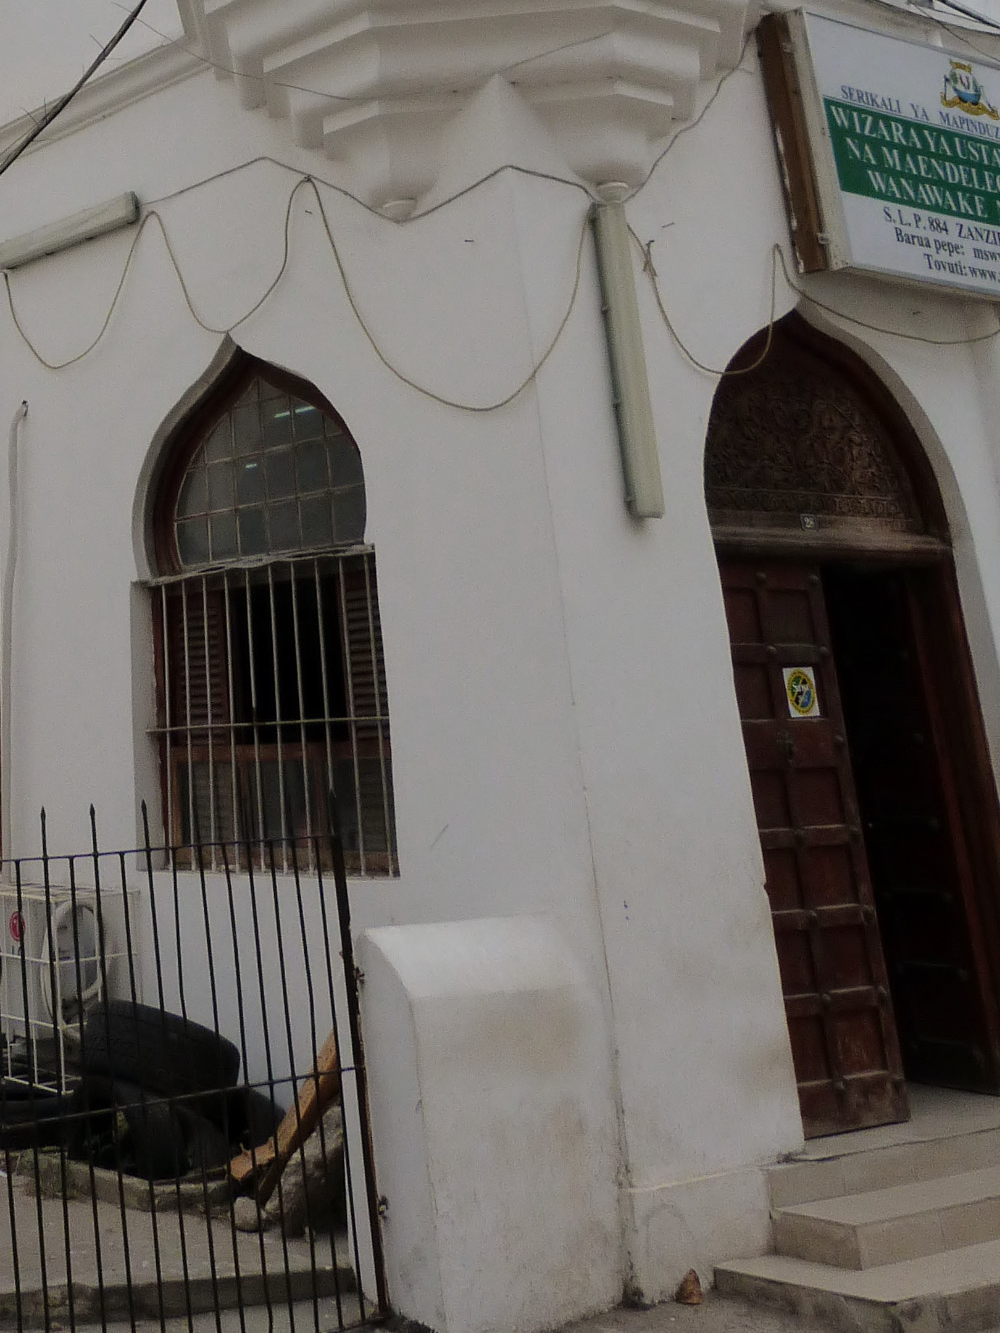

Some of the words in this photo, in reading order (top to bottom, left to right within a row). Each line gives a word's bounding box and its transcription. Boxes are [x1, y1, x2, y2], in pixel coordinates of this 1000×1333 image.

[841, 85, 901, 114] SERIKALI
[909, 103, 930, 121] YA
[830, 105, 922, 149] WIZARA
[923, 130, 952, 156] YA
[954, 137, 1000, 168] USTA
[845, 137, 876, 165] NA
[867, 169, 988, 218] WANAWAKE
[894, 226, 931, 249] Barua
[934, 238, 965, 257] pepe:
[928, 216, 949, 235] 884
